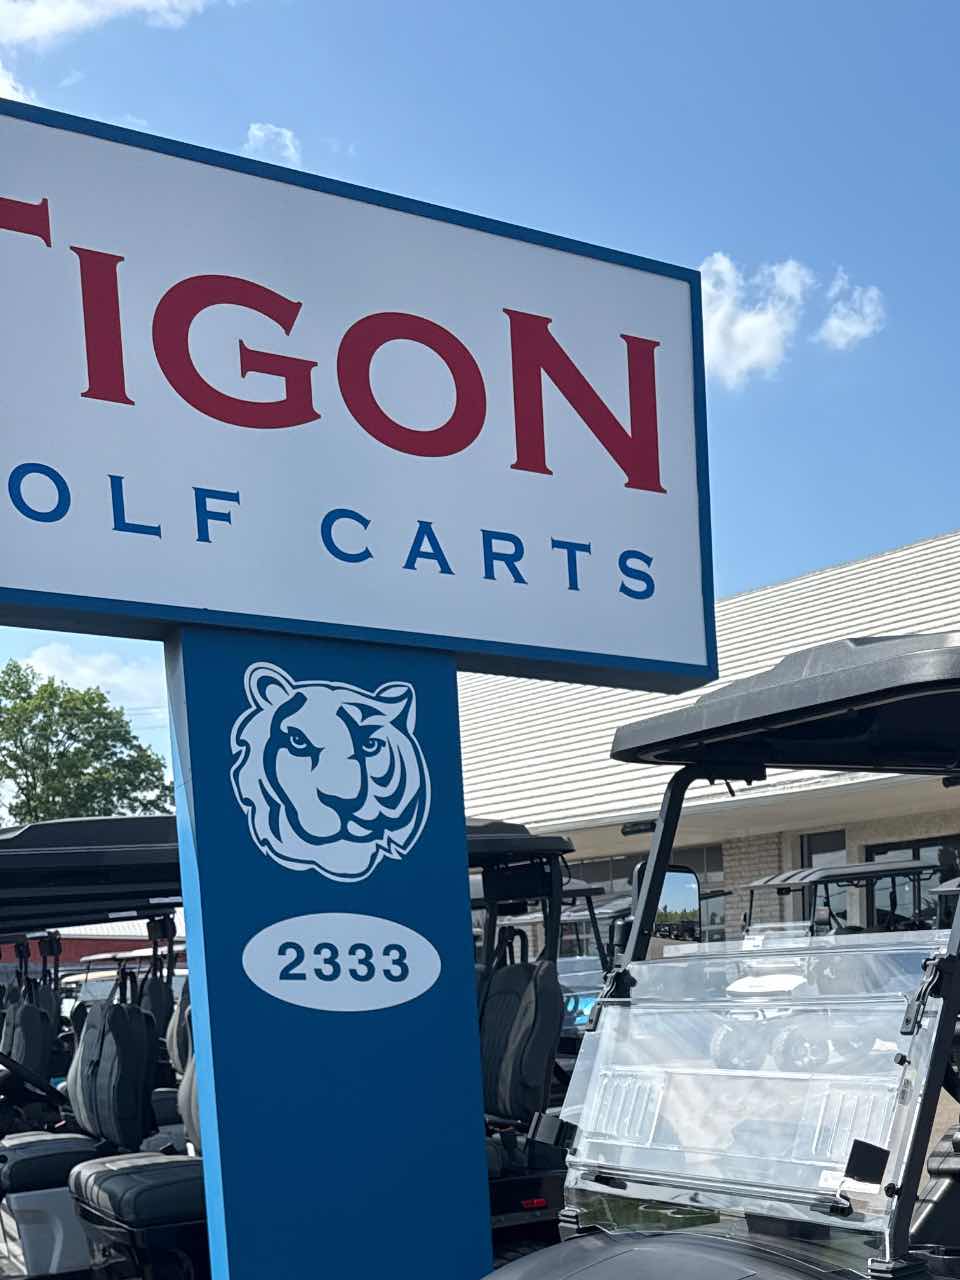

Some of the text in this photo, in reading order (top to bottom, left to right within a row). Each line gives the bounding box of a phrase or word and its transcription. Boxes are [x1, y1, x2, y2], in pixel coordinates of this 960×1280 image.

[7, 462, 656, 600] OLF CARTS
[277, 941, 410, 983] 2333
